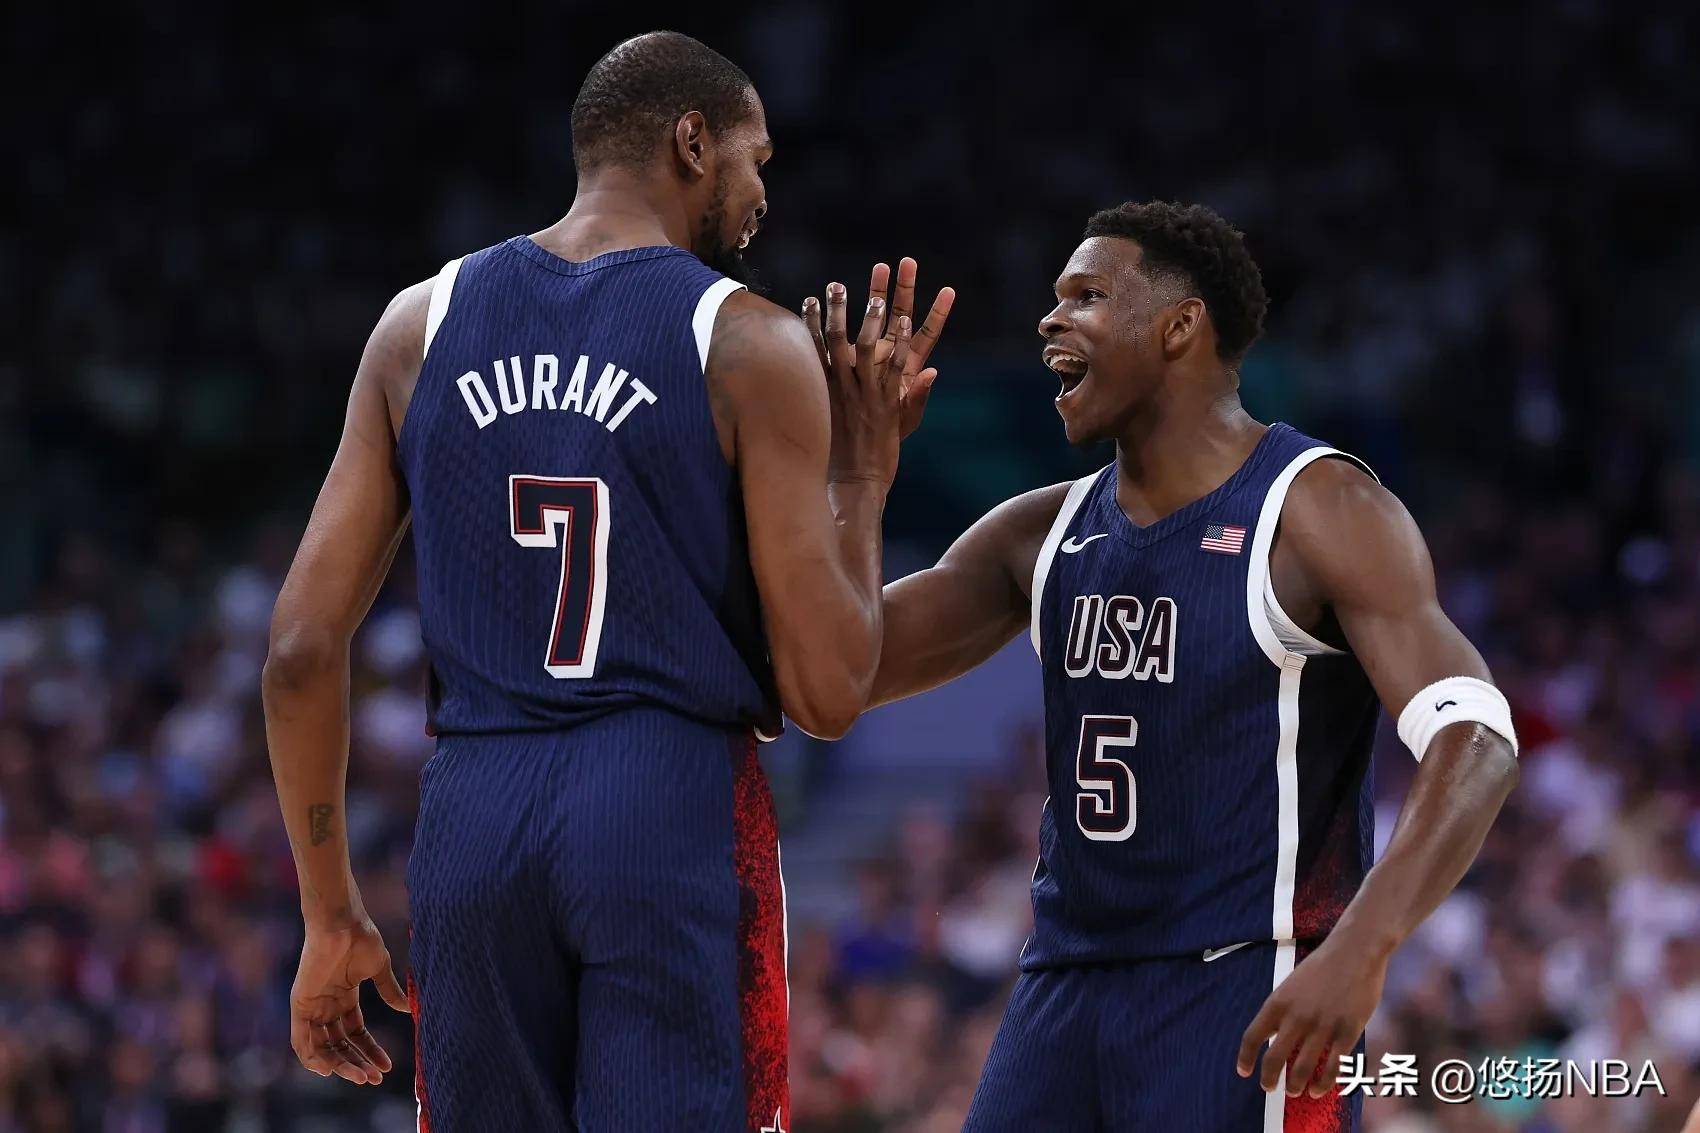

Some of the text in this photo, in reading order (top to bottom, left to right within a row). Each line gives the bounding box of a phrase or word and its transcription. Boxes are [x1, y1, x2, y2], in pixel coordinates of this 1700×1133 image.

[456, 354, 658, 433] DURANT
[508, 474, 611, 679] 7
[1065, 594, 1177, 683] USA
[1076, 714, 1138, 842] 5
